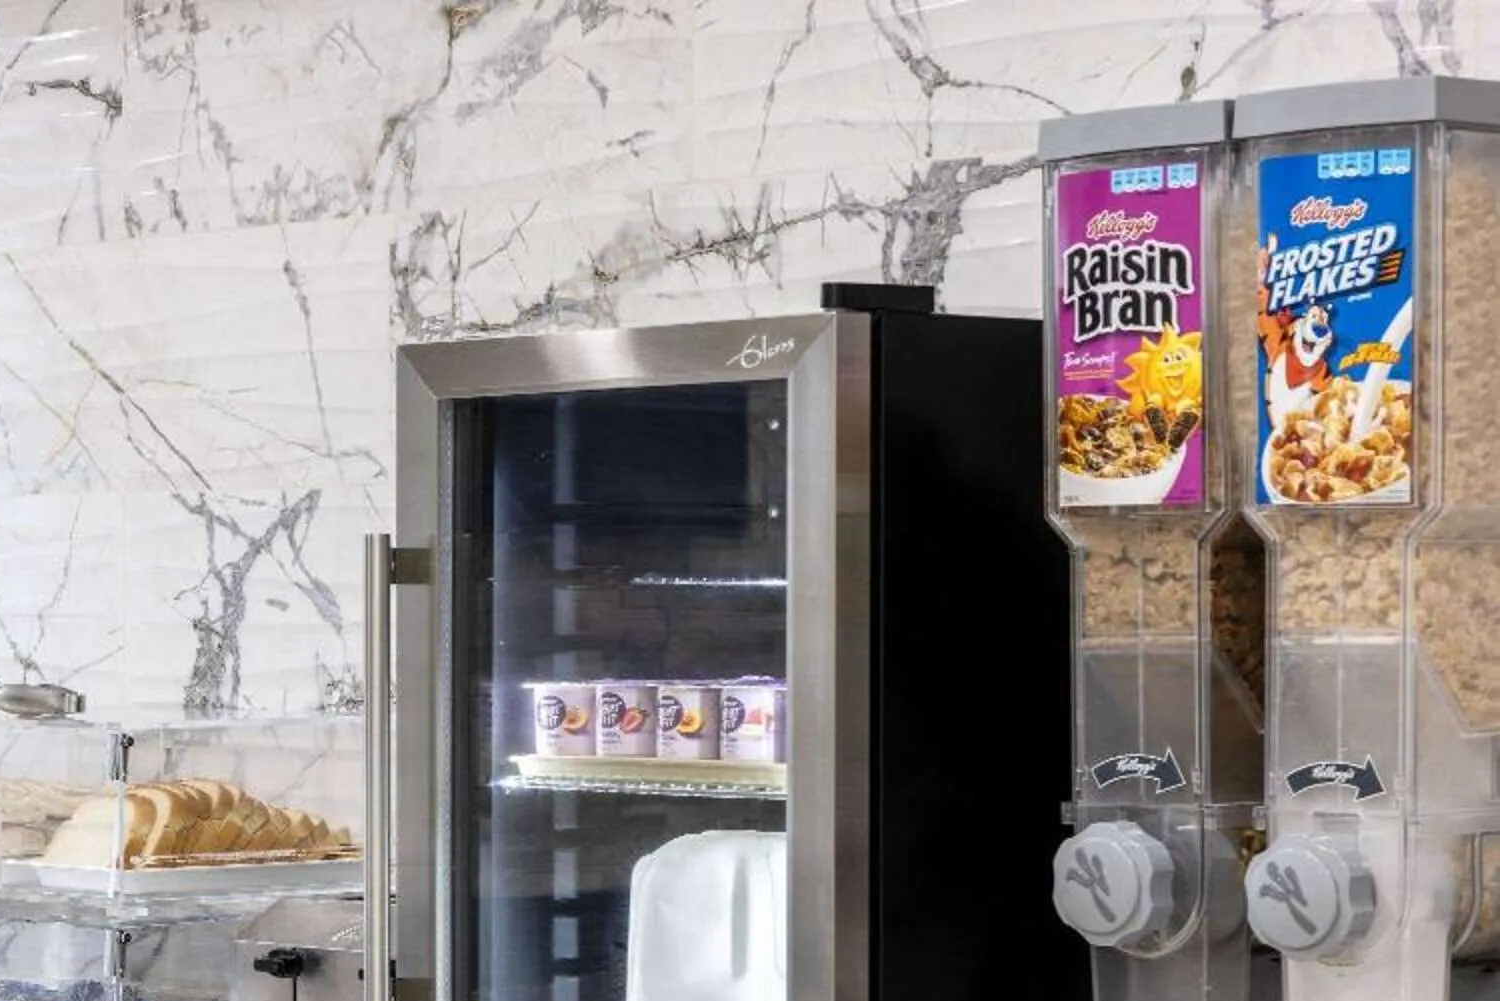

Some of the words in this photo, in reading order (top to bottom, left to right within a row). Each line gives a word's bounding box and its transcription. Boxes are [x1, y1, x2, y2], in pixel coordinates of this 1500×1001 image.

[1086, 209, 1159, 241] Kellogg's
[1289, 196, 1368, 230] Kellogg's
[1065, 241, 1193, 302] Raisin
[1268, 224, 1396, 283] FROSTED
[1269, 256, 1377, 309] FLAKES
[1075, 287, 1178, 341] Bran
